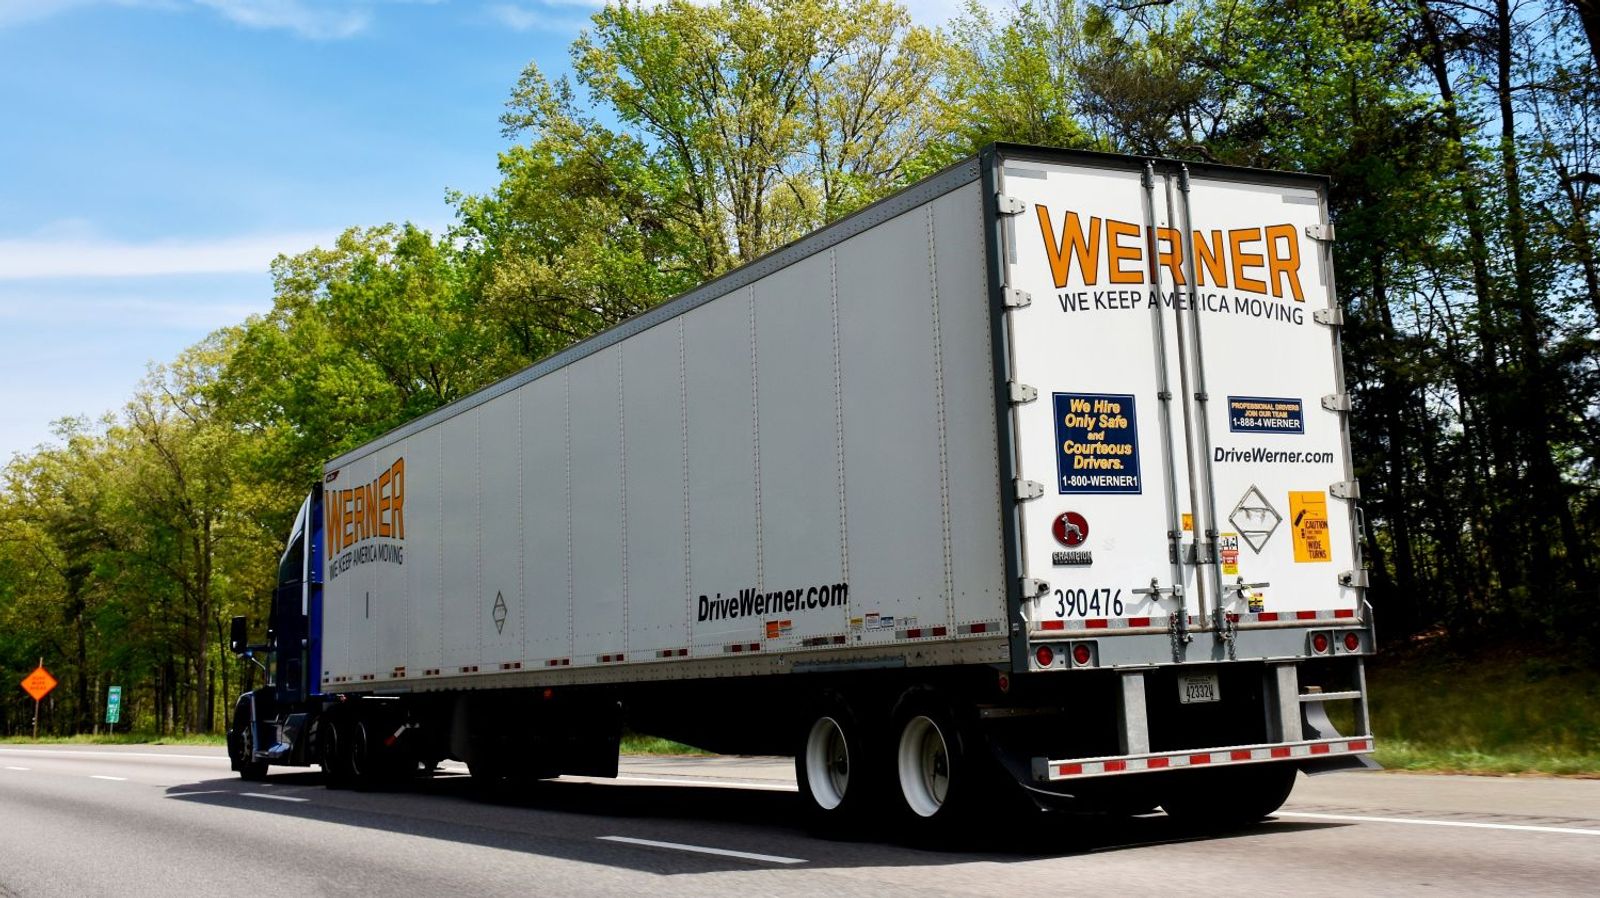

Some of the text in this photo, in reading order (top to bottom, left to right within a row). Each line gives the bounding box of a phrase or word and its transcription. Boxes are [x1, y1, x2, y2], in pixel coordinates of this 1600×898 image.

[1035, 204, 1305, 302] WERNER
[1058, 290, 1303, 325] WE KEEP AMERICA MOVING
[1070, 399, 1120, 414] We Hire
[1231, 403, 1274, 411] PROFESSIONAL
[1065, 413, 1128, 431] Only Safe
[1233, 417, 1301, 428] 1-888-4 WERNER
[1087, 431, 1105, 440] and
[1063, 440, 1132, 455] Courteous
[1214, 447, 1334, 463] DriveWerner.com
[1074, 455, 1124, 469] Drivers.
[1062, 475, 1138, 487] 1-800-WERNER1
[325, 456, 404, 561] WERNER
[1305, 520, 1328, 530] CAUTION
[329, 543, 403, 581] WE KEEP AMERICA MOVING
[1052, 551, 1092, 561] CHAMPION
[698, 582, 848, 622] DriveWerner.com
[1054, 588, 1123, 618] 390476
